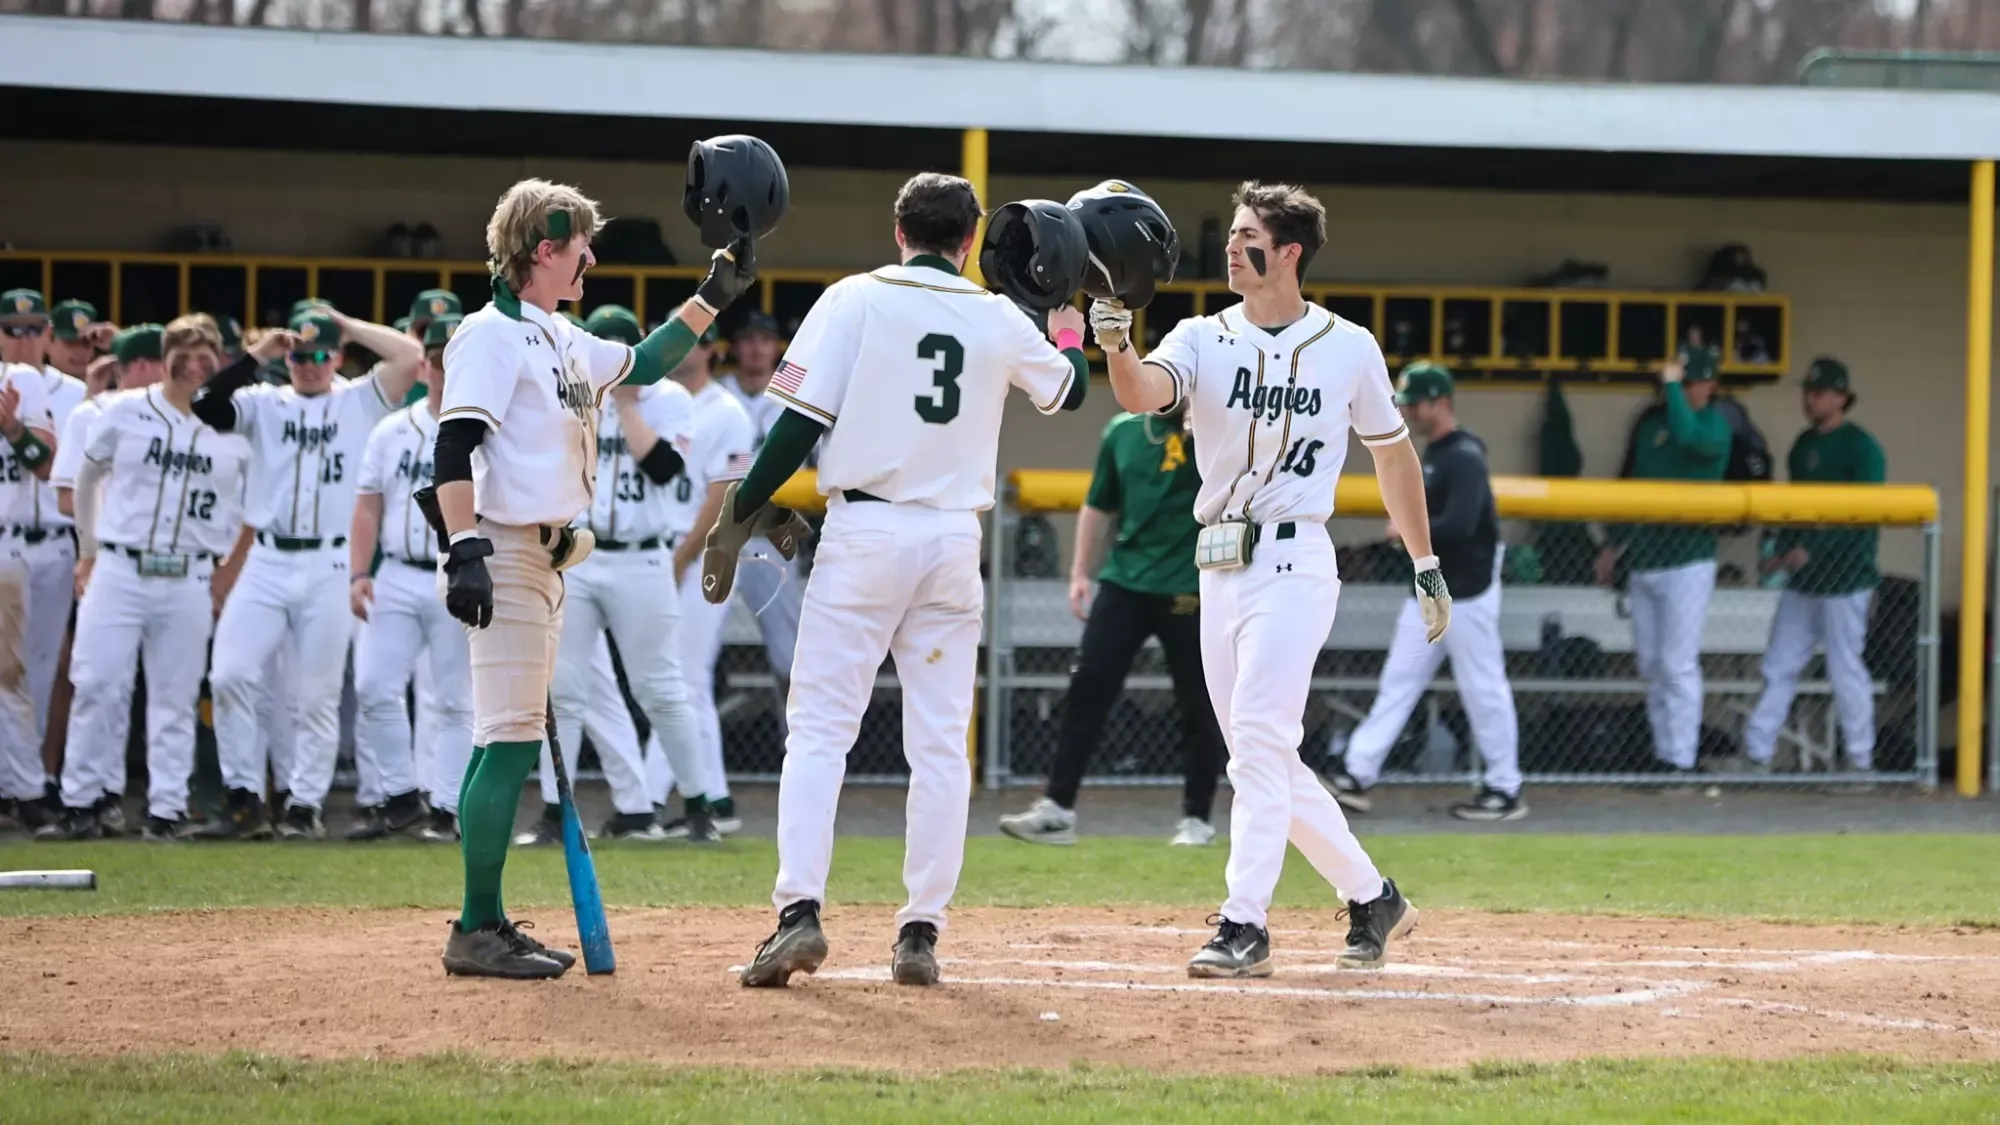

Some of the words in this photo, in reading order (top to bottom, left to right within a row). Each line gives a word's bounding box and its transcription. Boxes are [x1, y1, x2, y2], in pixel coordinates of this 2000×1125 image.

[914, 332, 964, 424] 3
[1226, 366, 1322, 421] Aggies
[281, 420, 338, 454] Aggies
[143, 436, 212, 480] Aggies
[323, 452, 345, 483] 15
[617, 472, 645, 502] 33
[187, 490, 217, 520] 12
